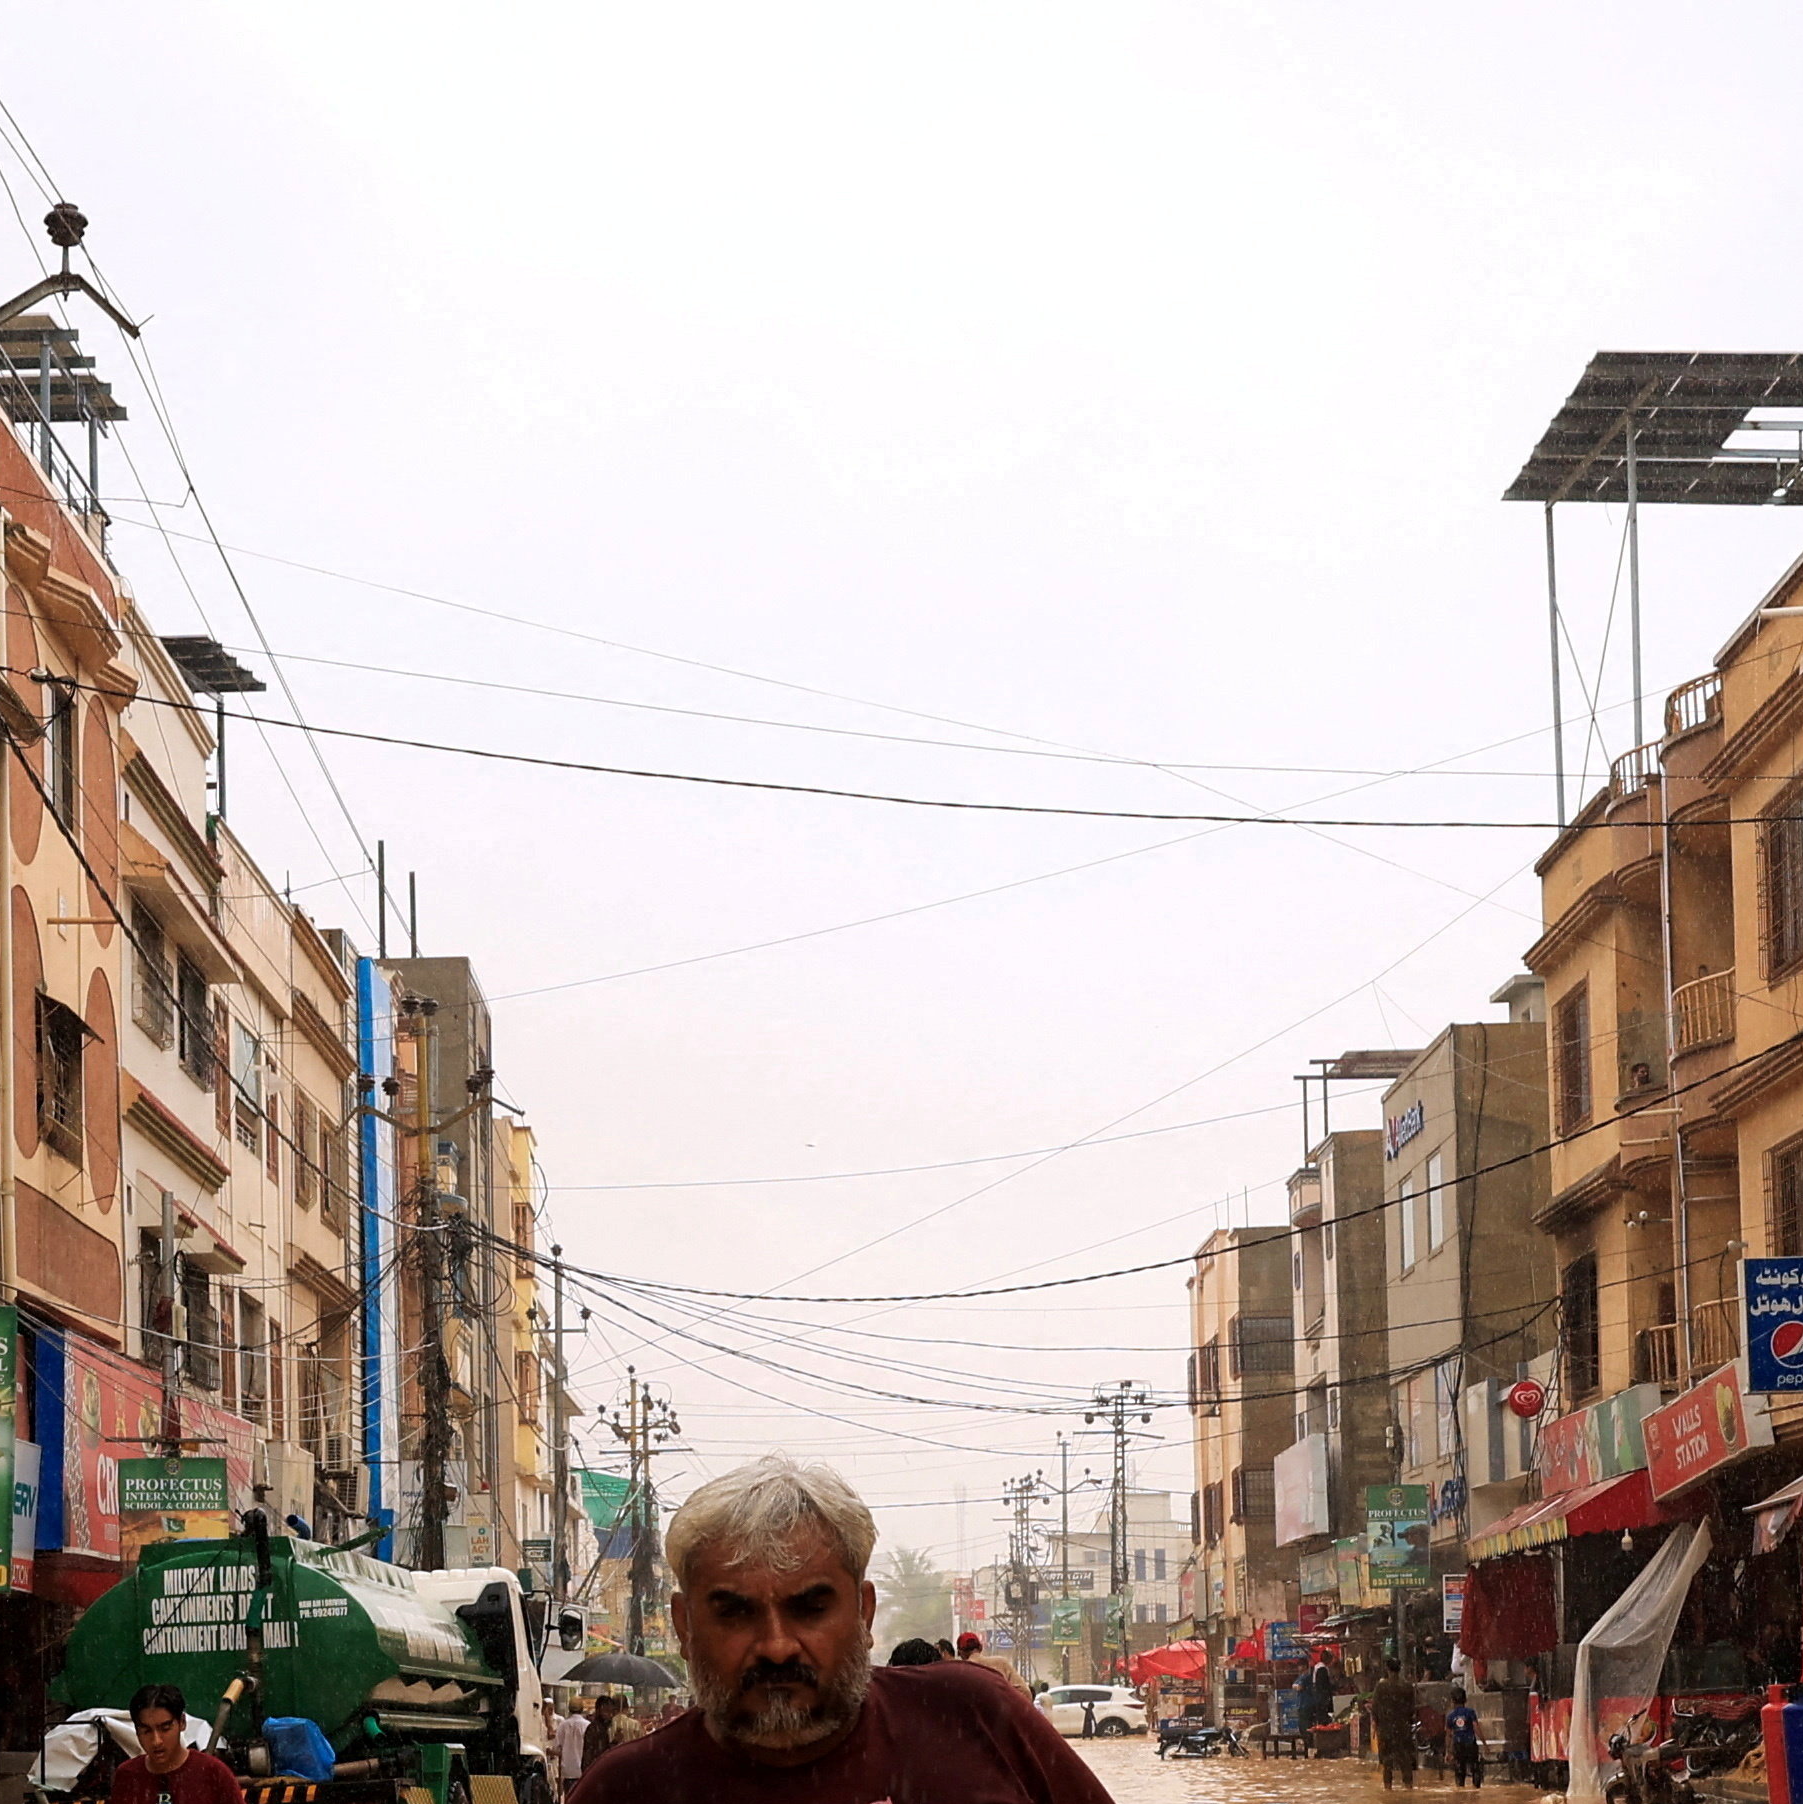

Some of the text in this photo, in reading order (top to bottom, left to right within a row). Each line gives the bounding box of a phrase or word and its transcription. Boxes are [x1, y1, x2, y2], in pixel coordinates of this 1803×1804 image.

[1672, 1404, 1702, 1440] WALLS
[1676, 1432, 1709, 1470] STATION
[124, 1478, 222, 1491] PROFECTUS
[125, 1491, 222, 1501] INTERNATIONAL
[124, 1501, 221, 1510] SCHOOL & COLLEGE
[1368, 1508, 1427, 1518] PROFECTUS
[164, 1565, 256, 1595] MILITARY LANDS
[152, 1595, 234, 1625] CANTONMENTS
[143, 1627, 218, 1655] CANTONMENT
